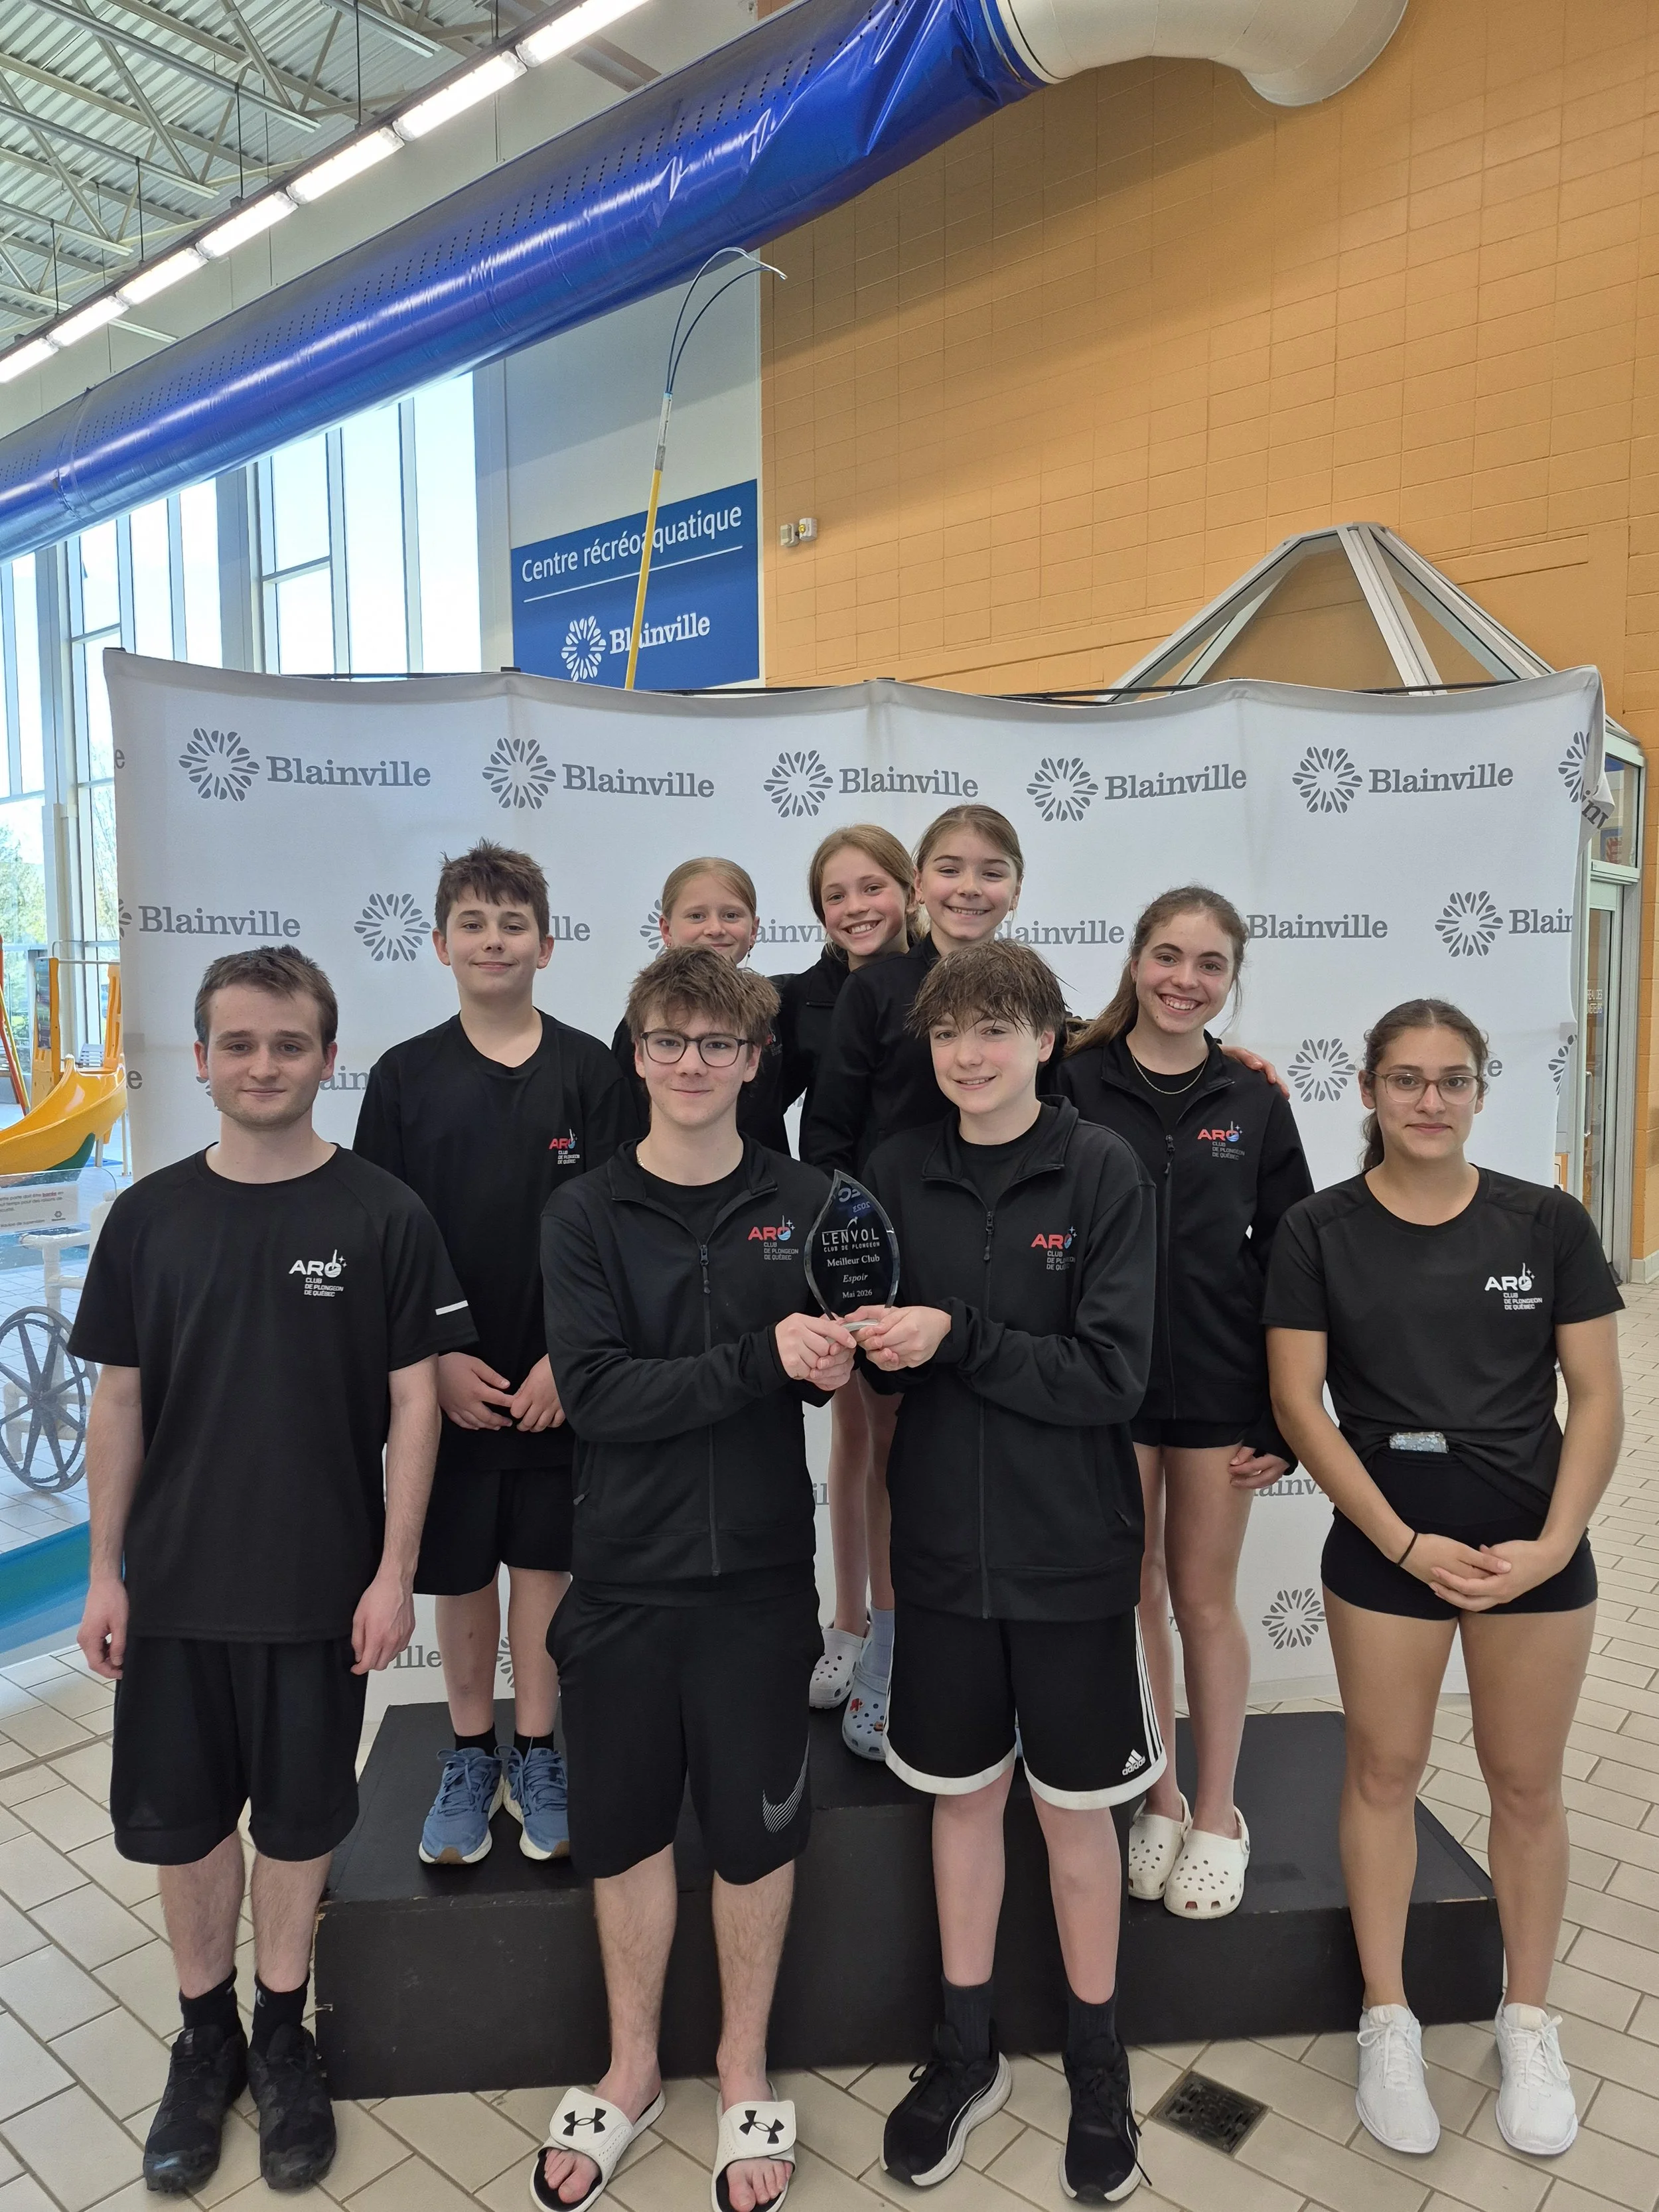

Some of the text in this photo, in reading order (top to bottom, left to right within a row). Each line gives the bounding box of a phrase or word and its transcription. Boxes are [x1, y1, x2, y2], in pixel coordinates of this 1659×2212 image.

[522, 552, 578, 583] Centre
[266, 755, 431, 787] Blainville
[561, 763, 715, 798] Blainville
[839, 766, 979, 798] Blainville
[1104, 763, 1248, 800] Blainville
[1368, 763, 1514, 794] Blainville
[137, 905, 301, 938] Blainville
[1246, 914, 1388, 939] Blainville
[1197, 1128, 1240, 1142] ARO
[747, 1226, 792, 1241] ARO
[288, 1258, 342, 1278] ARO
[827, 1254, 881, 1268] Meilleur Club
[843, 1273, 869, 1284] Espoir
[1484, 1274, 1532, 1291] ARO
[842, 1289, 873, 1299] Mai 2026
